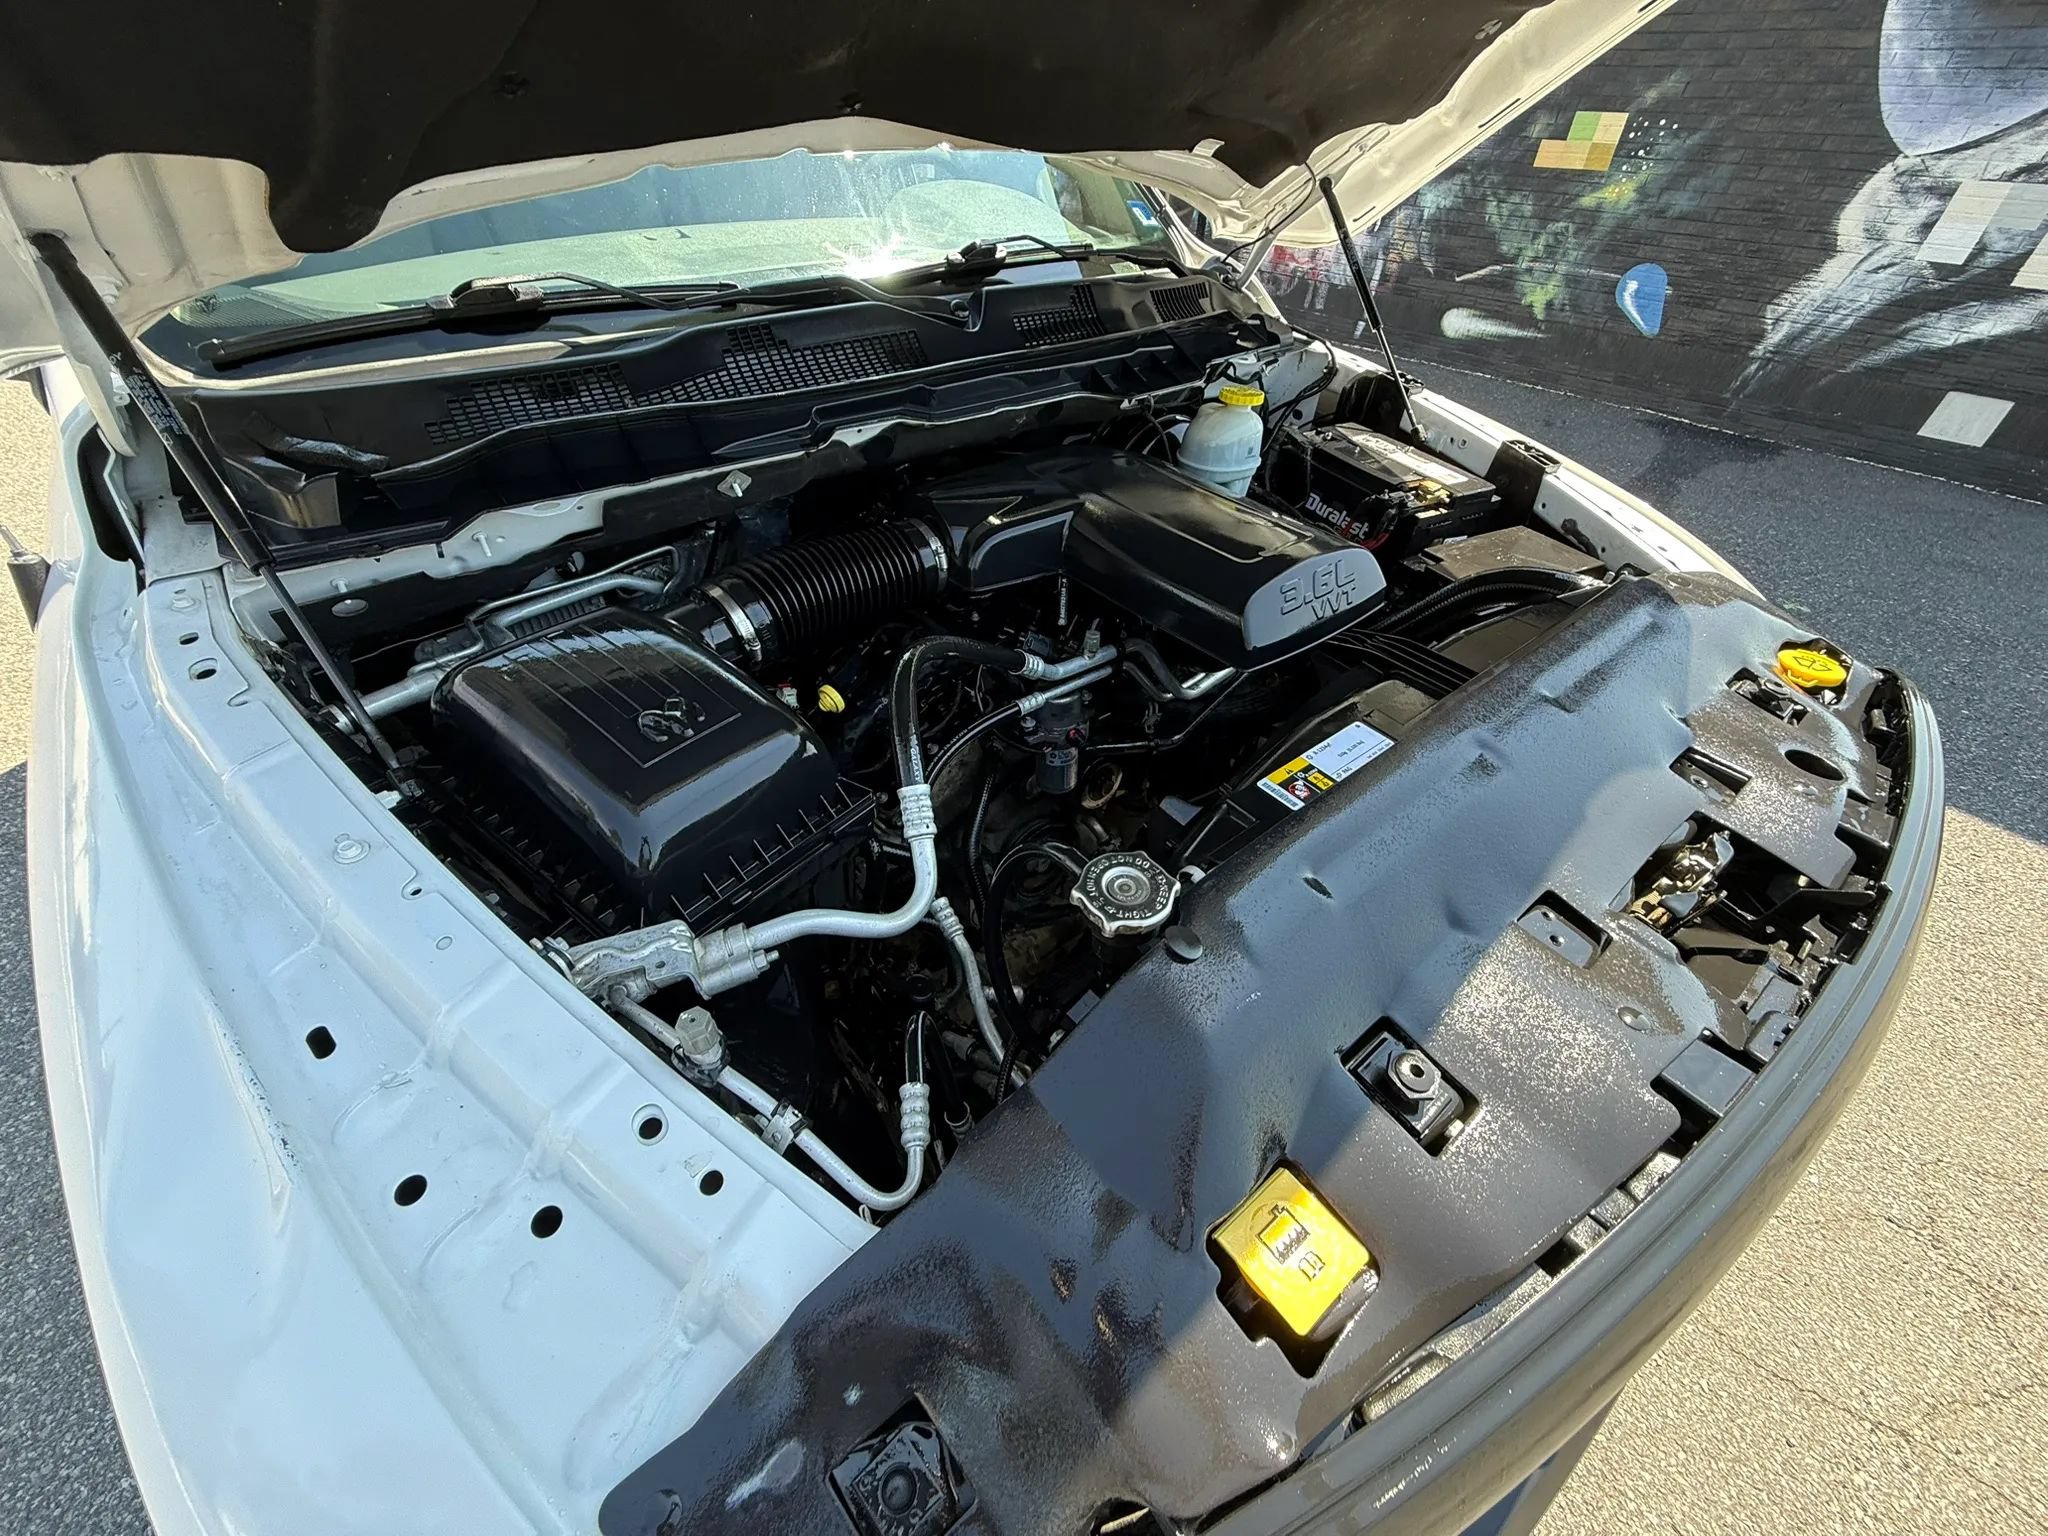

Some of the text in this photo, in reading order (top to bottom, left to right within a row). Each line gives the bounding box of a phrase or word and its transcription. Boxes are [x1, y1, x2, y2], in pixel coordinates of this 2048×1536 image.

[1305, 492, 1369, 539] Duralast
[1280, 559, 1356, 616] 3.6L
[1311, 586, 1357, 620] VVT
[911, 748, 920, 782] GALAXY
[1111, 855, 1133, 864] NOT
[1135, 857, 1150, 869] DO
[1116, 909, 1153, 919] TIGHT
